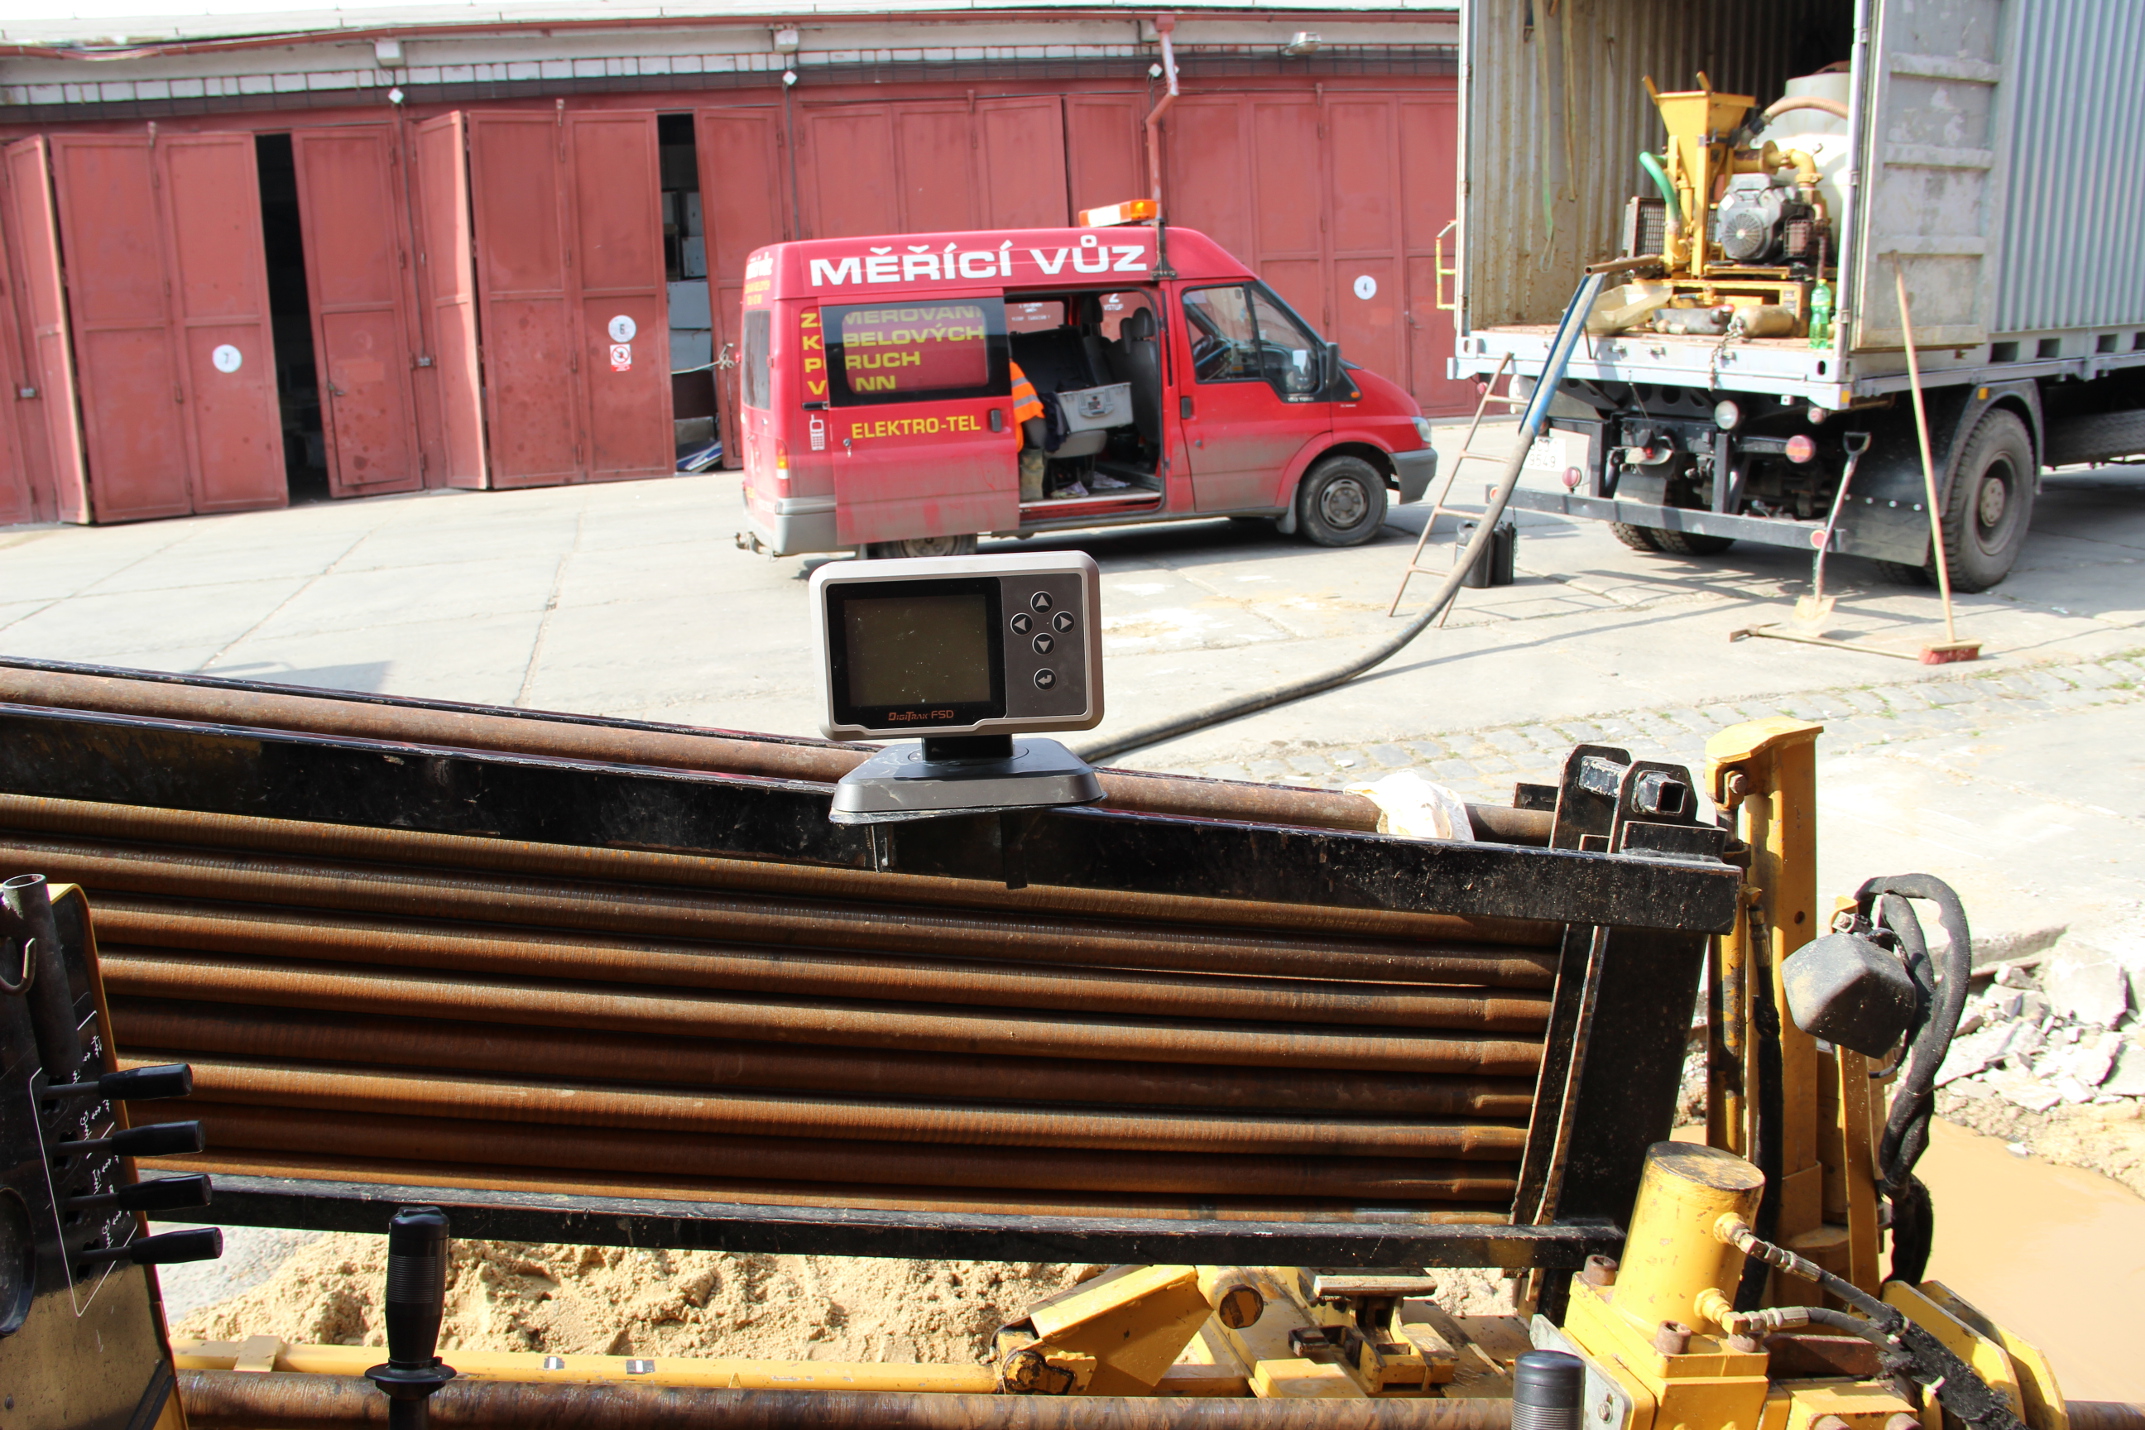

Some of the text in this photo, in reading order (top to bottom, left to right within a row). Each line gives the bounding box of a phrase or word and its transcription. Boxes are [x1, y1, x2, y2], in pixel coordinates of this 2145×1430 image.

[810, 239, 1014, 286] MĚŘÍCÍ
[1029, 235, 1148, 275] VŮZ
[851, 415, 982, 440] ELEKTRO-TEL
[931, 709, 955, 719] FSD
